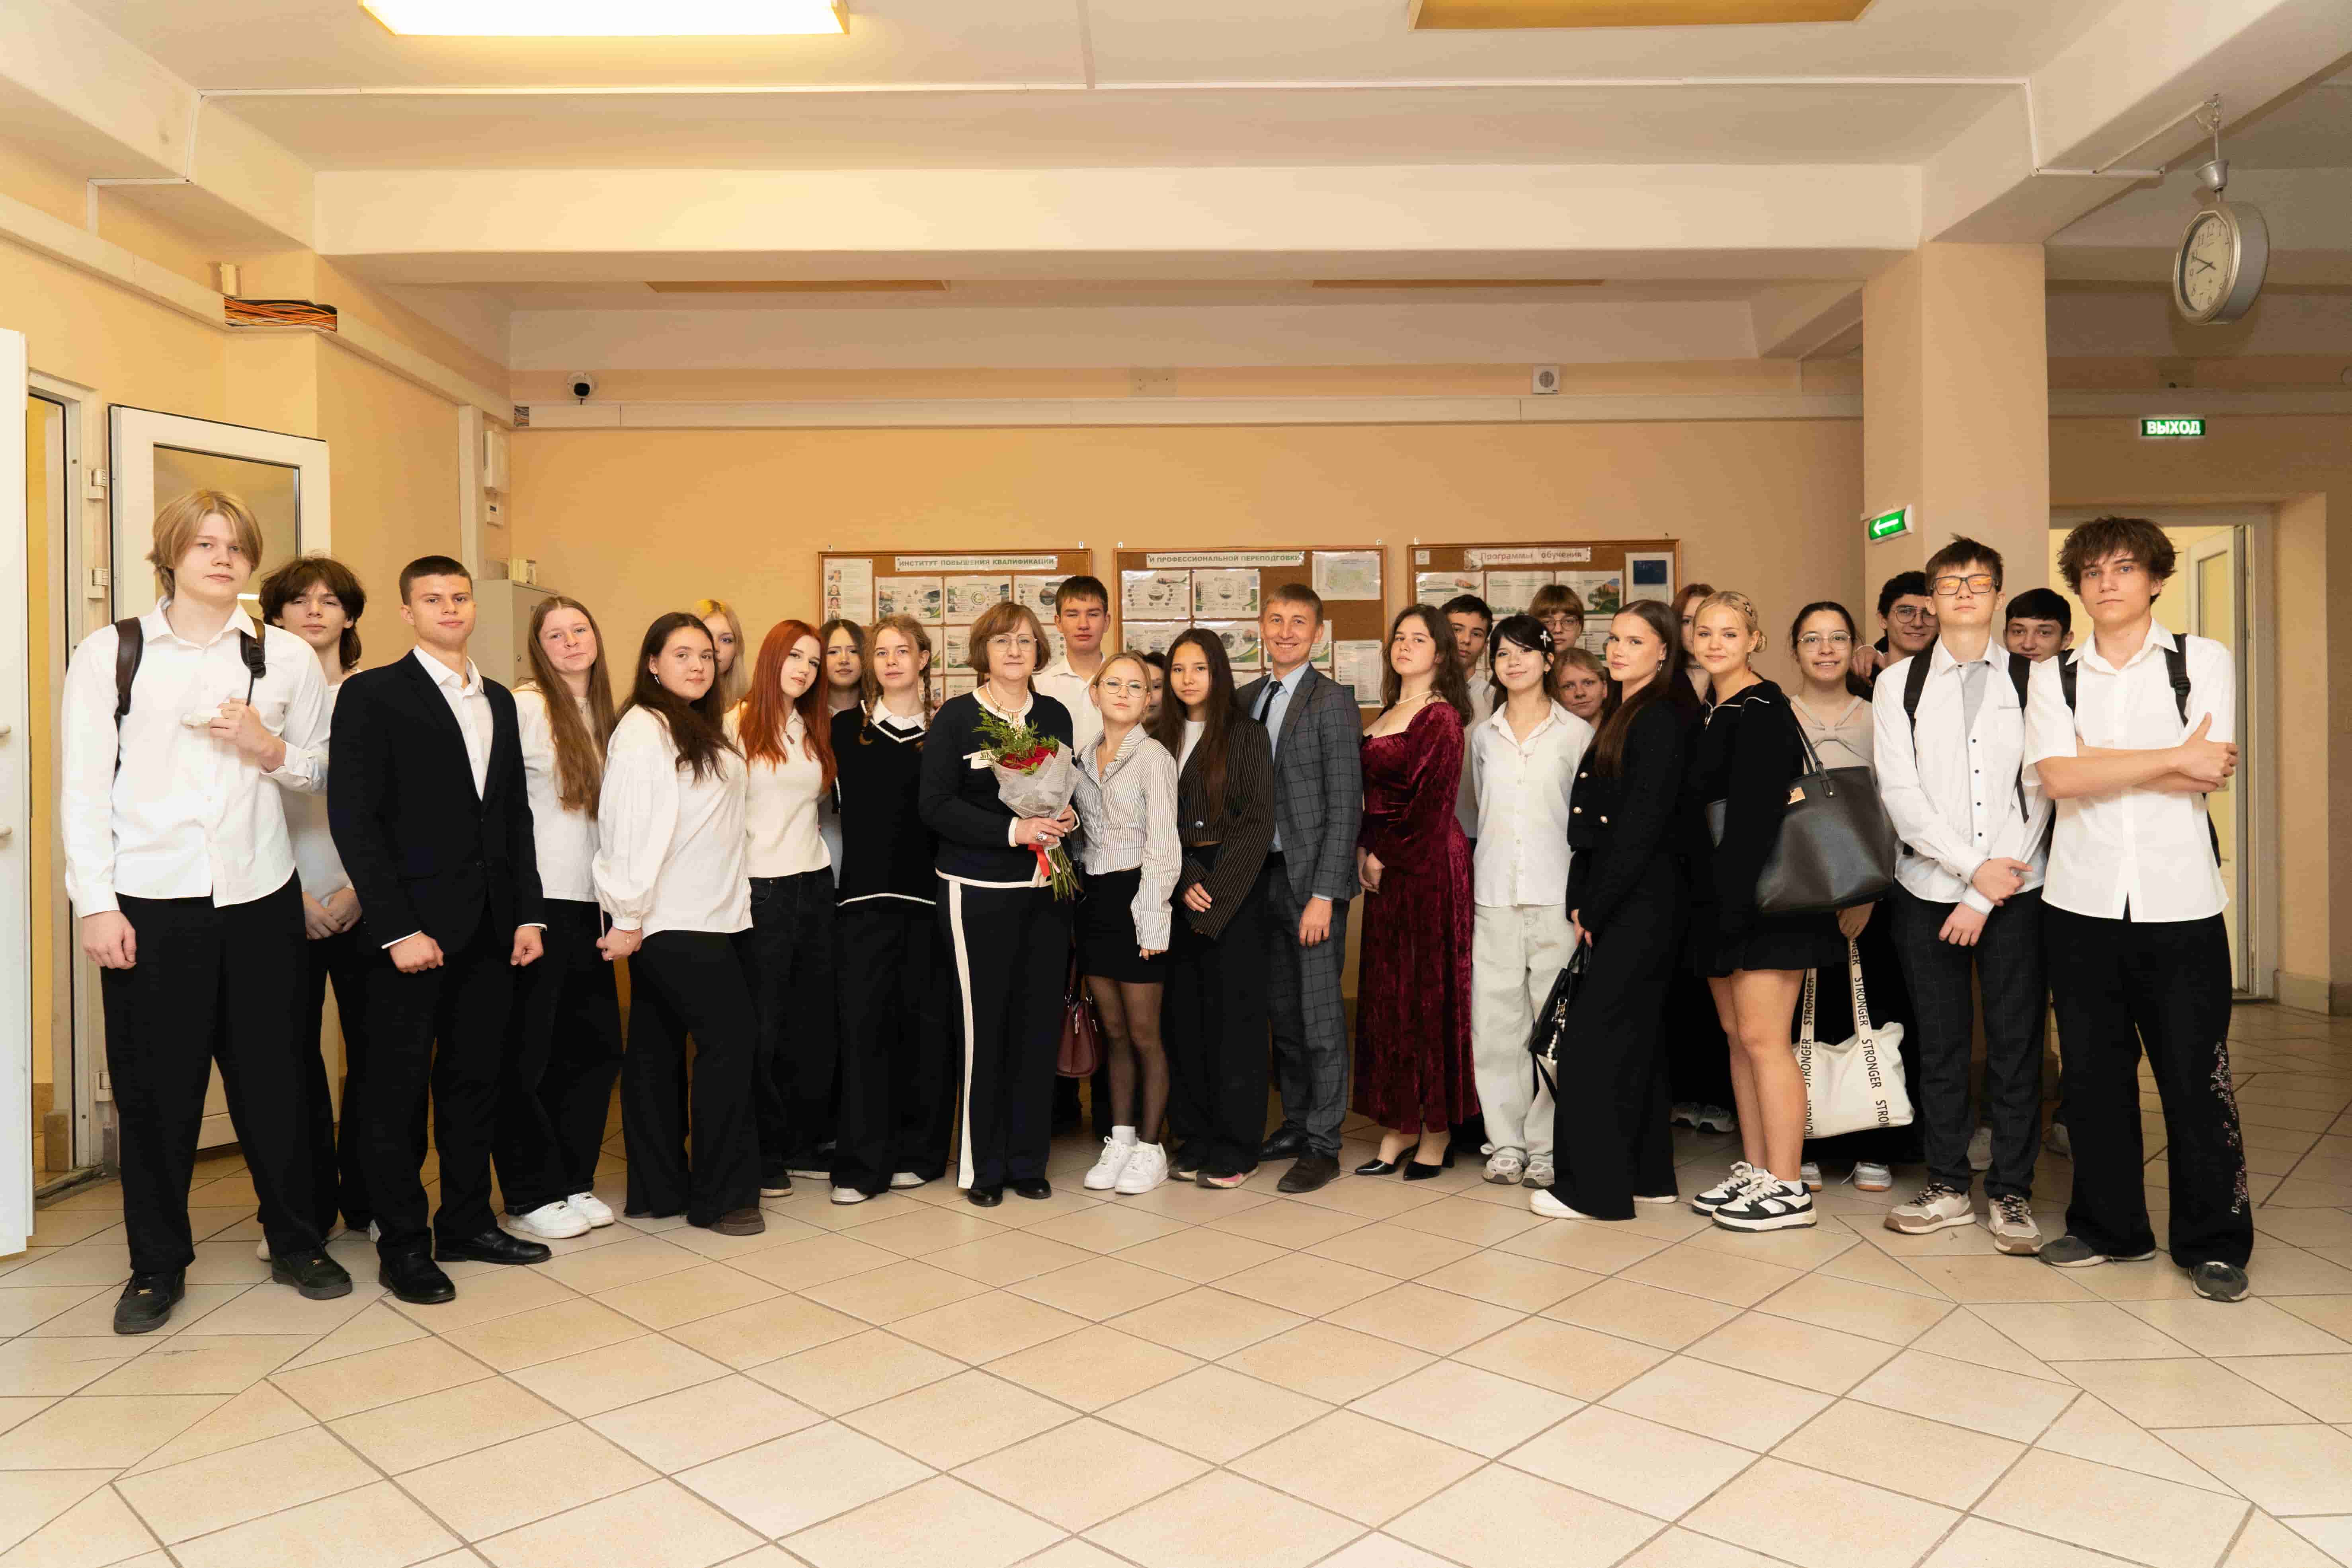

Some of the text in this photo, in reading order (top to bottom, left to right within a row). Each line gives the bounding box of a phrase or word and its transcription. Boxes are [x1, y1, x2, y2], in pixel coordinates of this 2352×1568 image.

[2207, 223, 2214, 238] 12
[2219, 224, 2222, 236] 1
[2198, 233, 2204, 247] 11
[2147, 421, 2201, 435] ВЫХОД
[1480, 551, 1582, 561] Программы обучения
[1803, 978, 1814, 1025] STRONGER
[1854, 977, 1869, 1026] STRONGER
[1862, 1039, 1882, 1089] STRONGER
